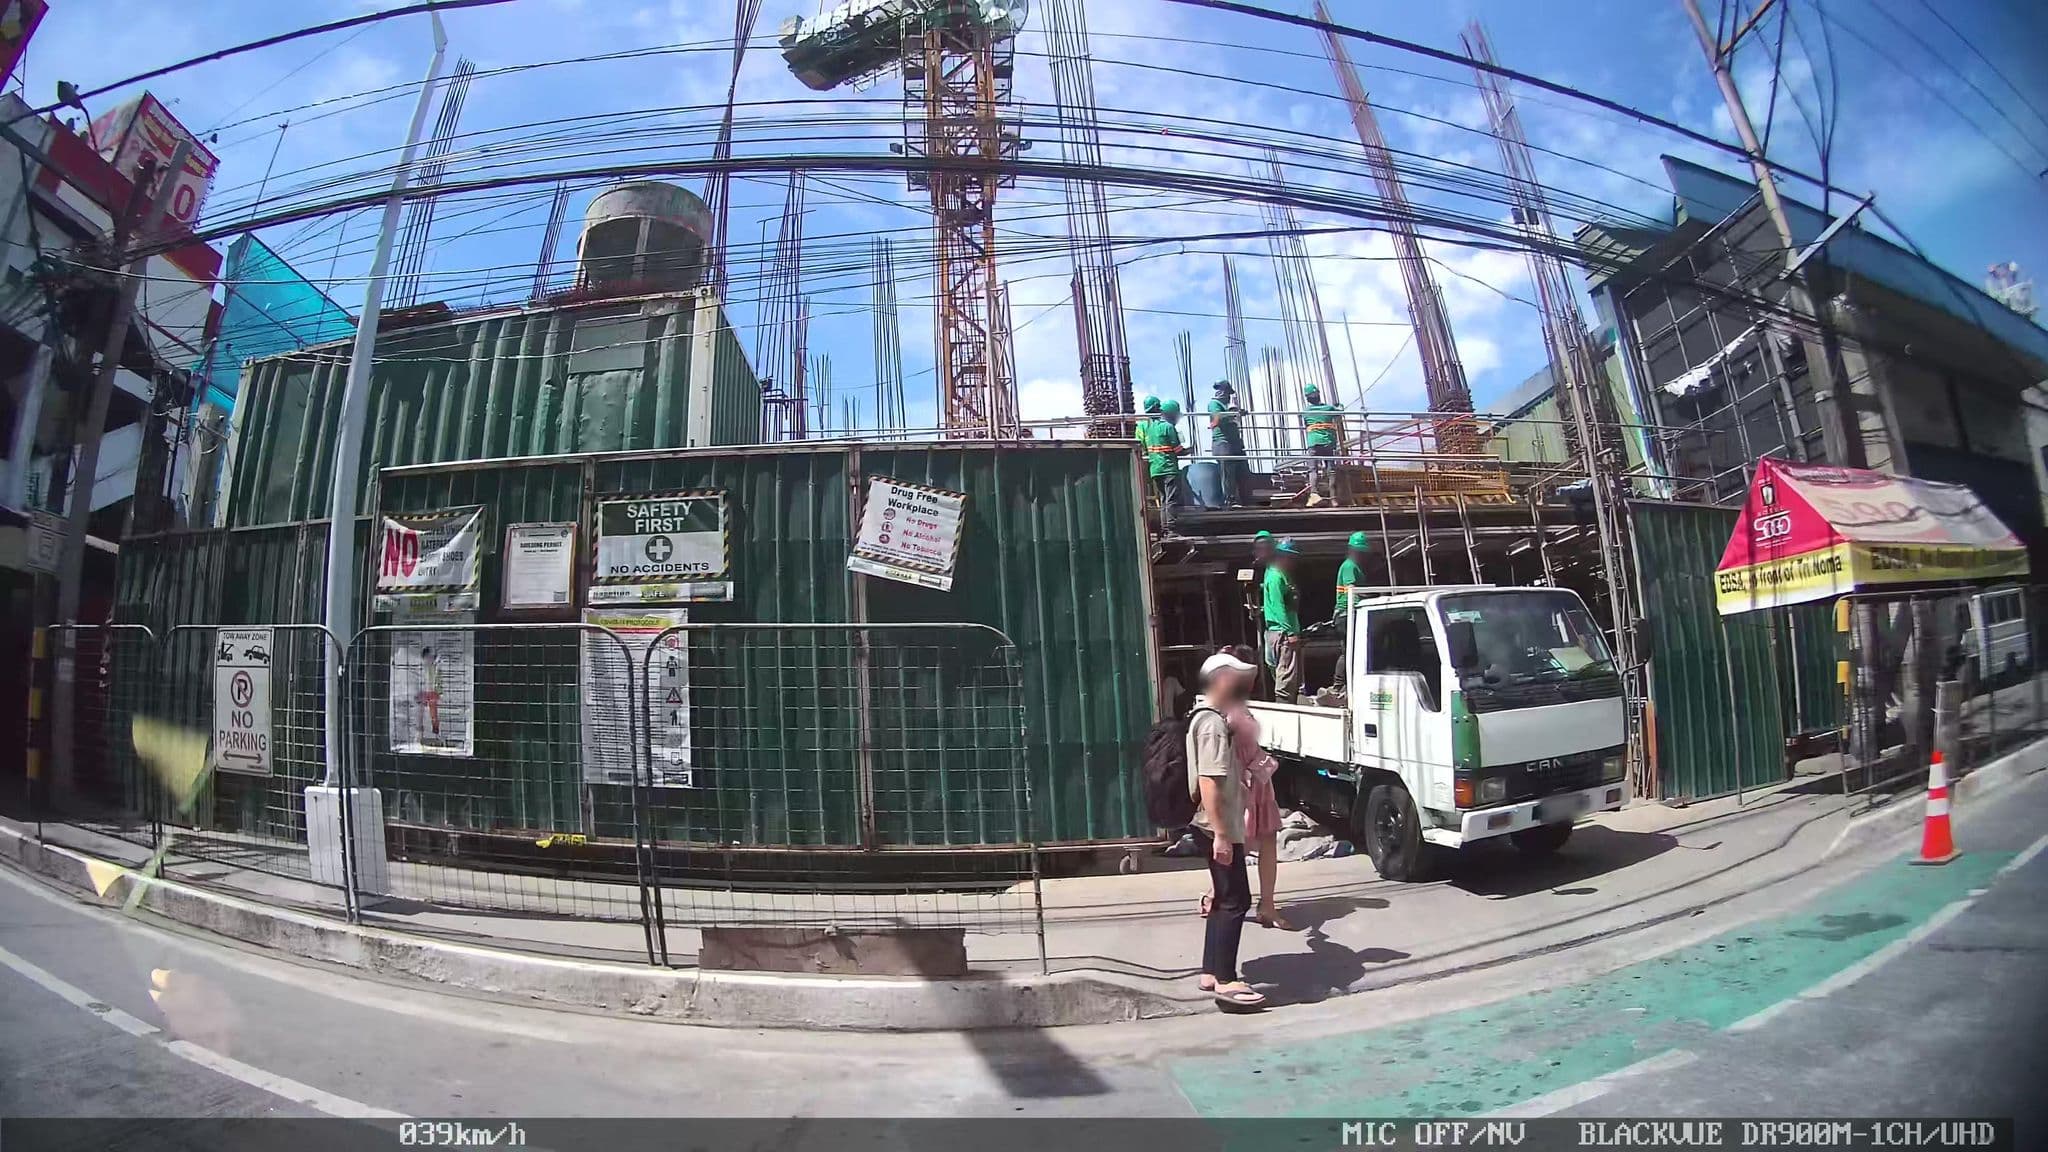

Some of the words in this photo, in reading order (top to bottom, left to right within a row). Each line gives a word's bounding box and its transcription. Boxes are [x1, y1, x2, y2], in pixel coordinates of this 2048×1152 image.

[890, 486, 914, 500] Drug
[916, 491, 938, 504] Free
[627, 501, 693, 519] SAFETY
[888, 498, 940, 517] Workplace
[635, 517, 685, 533] FIRST
[906, 516, 916, 525] No
[903, 529, 912, 537] No
[383, 529, 418, 577] NO
[900, 541, 910, 550] No
[610, 564, 629, 576] NO
[632, 562, 710, 574] ACCIDENTS
[223, 632, 235, 640] TOW
[235, 632, 250, 641] AWAY
[251, 632, 268, 641] ZONE
[231, 709, 254, 729] NO
[219, 730, 267, 751] PARKING
